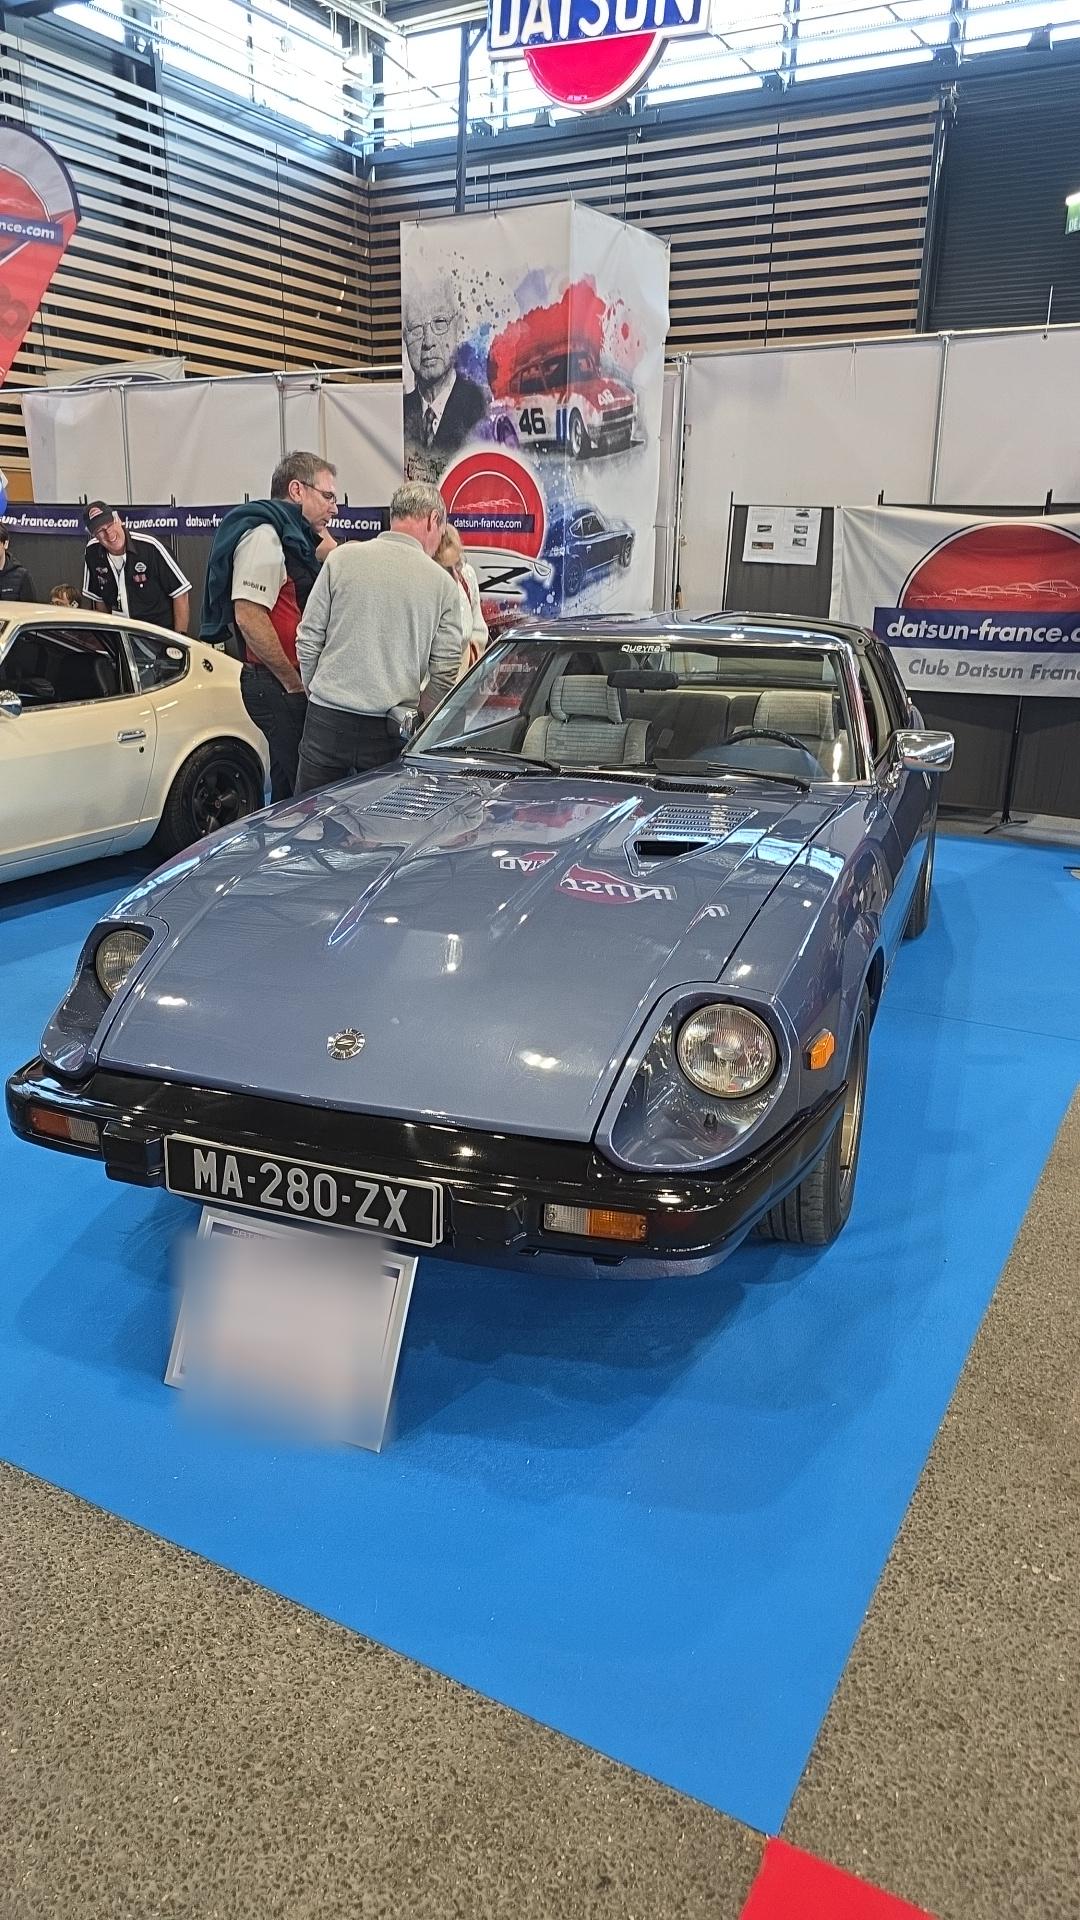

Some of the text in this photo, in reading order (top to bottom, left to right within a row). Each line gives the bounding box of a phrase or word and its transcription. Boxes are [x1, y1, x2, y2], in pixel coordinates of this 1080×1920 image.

[519, 407, 546, 435] 46
[453, 517, 522, 529] datsun-france.com
[908, 658, 1080, 681] Club Datsun Fran
[193, 1148, 408, 1233] MA-280-ZX
